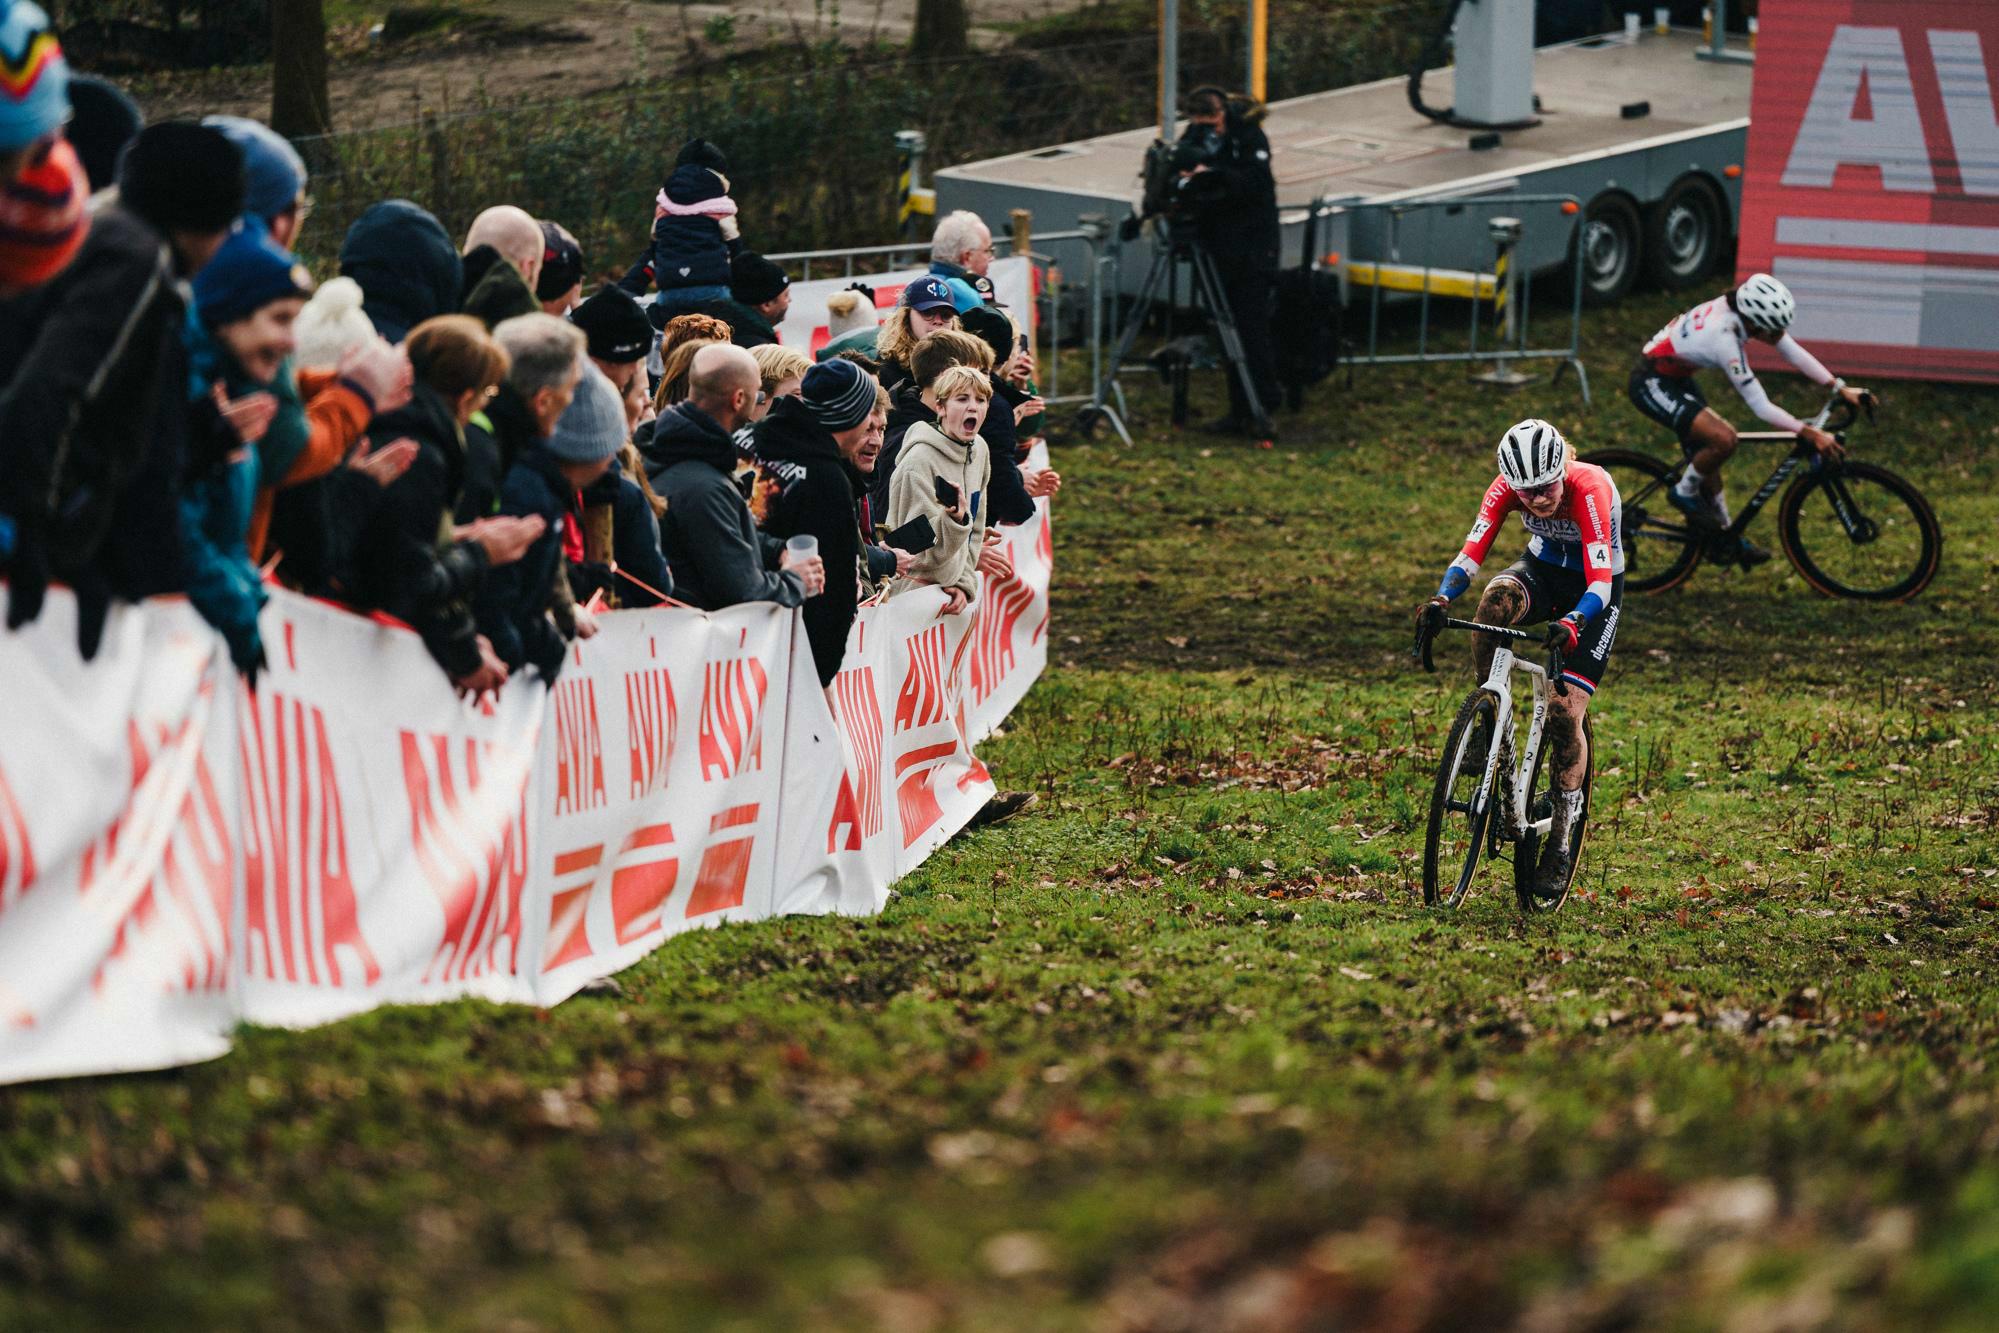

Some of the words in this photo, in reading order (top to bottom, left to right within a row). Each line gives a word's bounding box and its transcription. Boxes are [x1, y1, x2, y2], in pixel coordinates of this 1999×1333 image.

[1585, 494, 1605, 541] deceuninck
[1596, 549, 1606, 562] 4
[1590, 605, 1620, 661] deceuninck
[555, 677, 608, 817] AVIA
[625, 667, 677, 801] AVIA
[699, 657, 768, 782] AVIA
